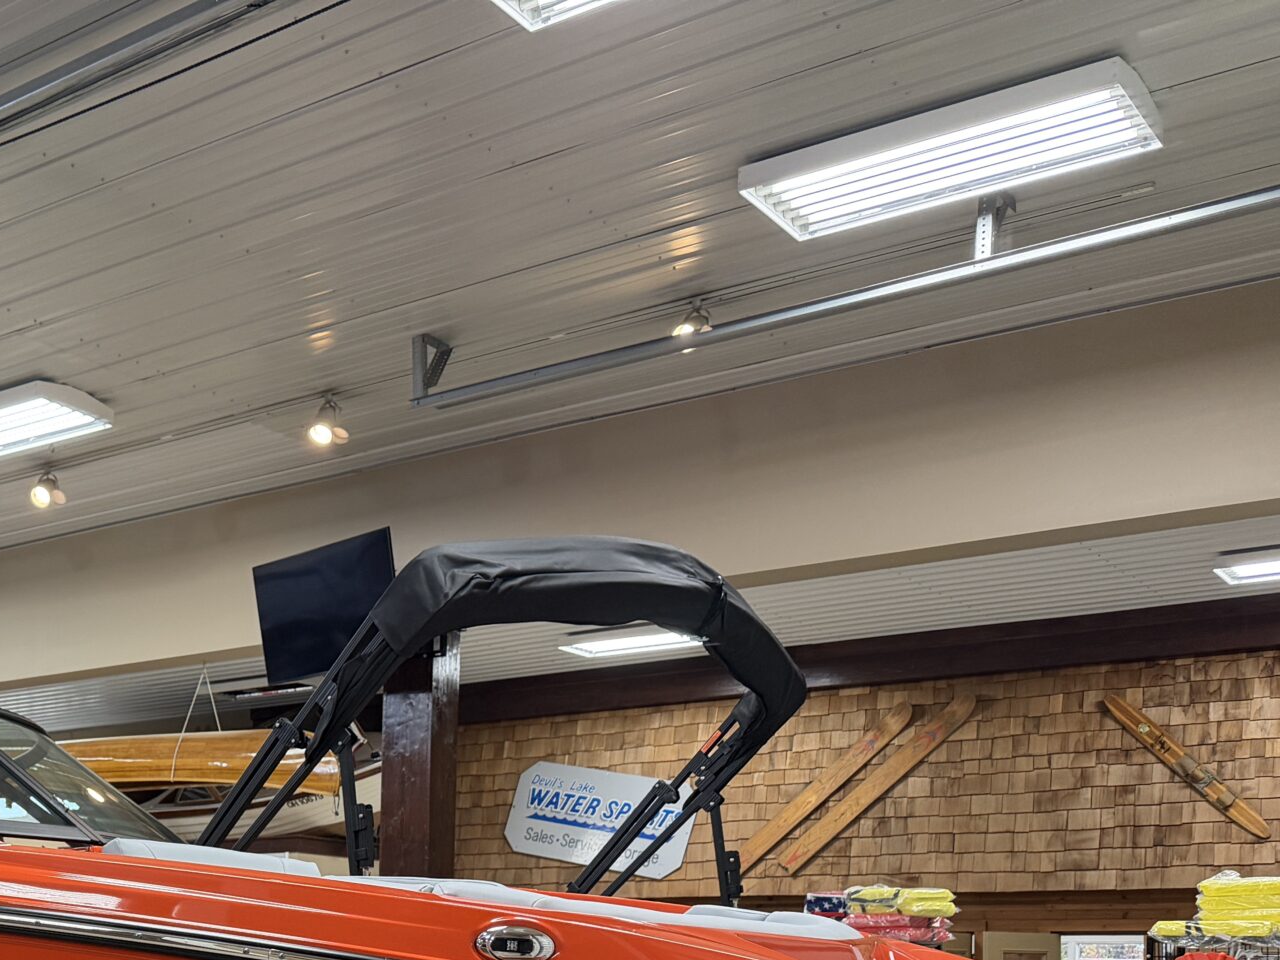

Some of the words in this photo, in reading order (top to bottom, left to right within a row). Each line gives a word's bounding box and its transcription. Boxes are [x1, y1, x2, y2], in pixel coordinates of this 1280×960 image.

[531, 774, 564, 788] Devil's
[570, 781, 596, 793] Lake
[529, 787, 601, 814] WATER
